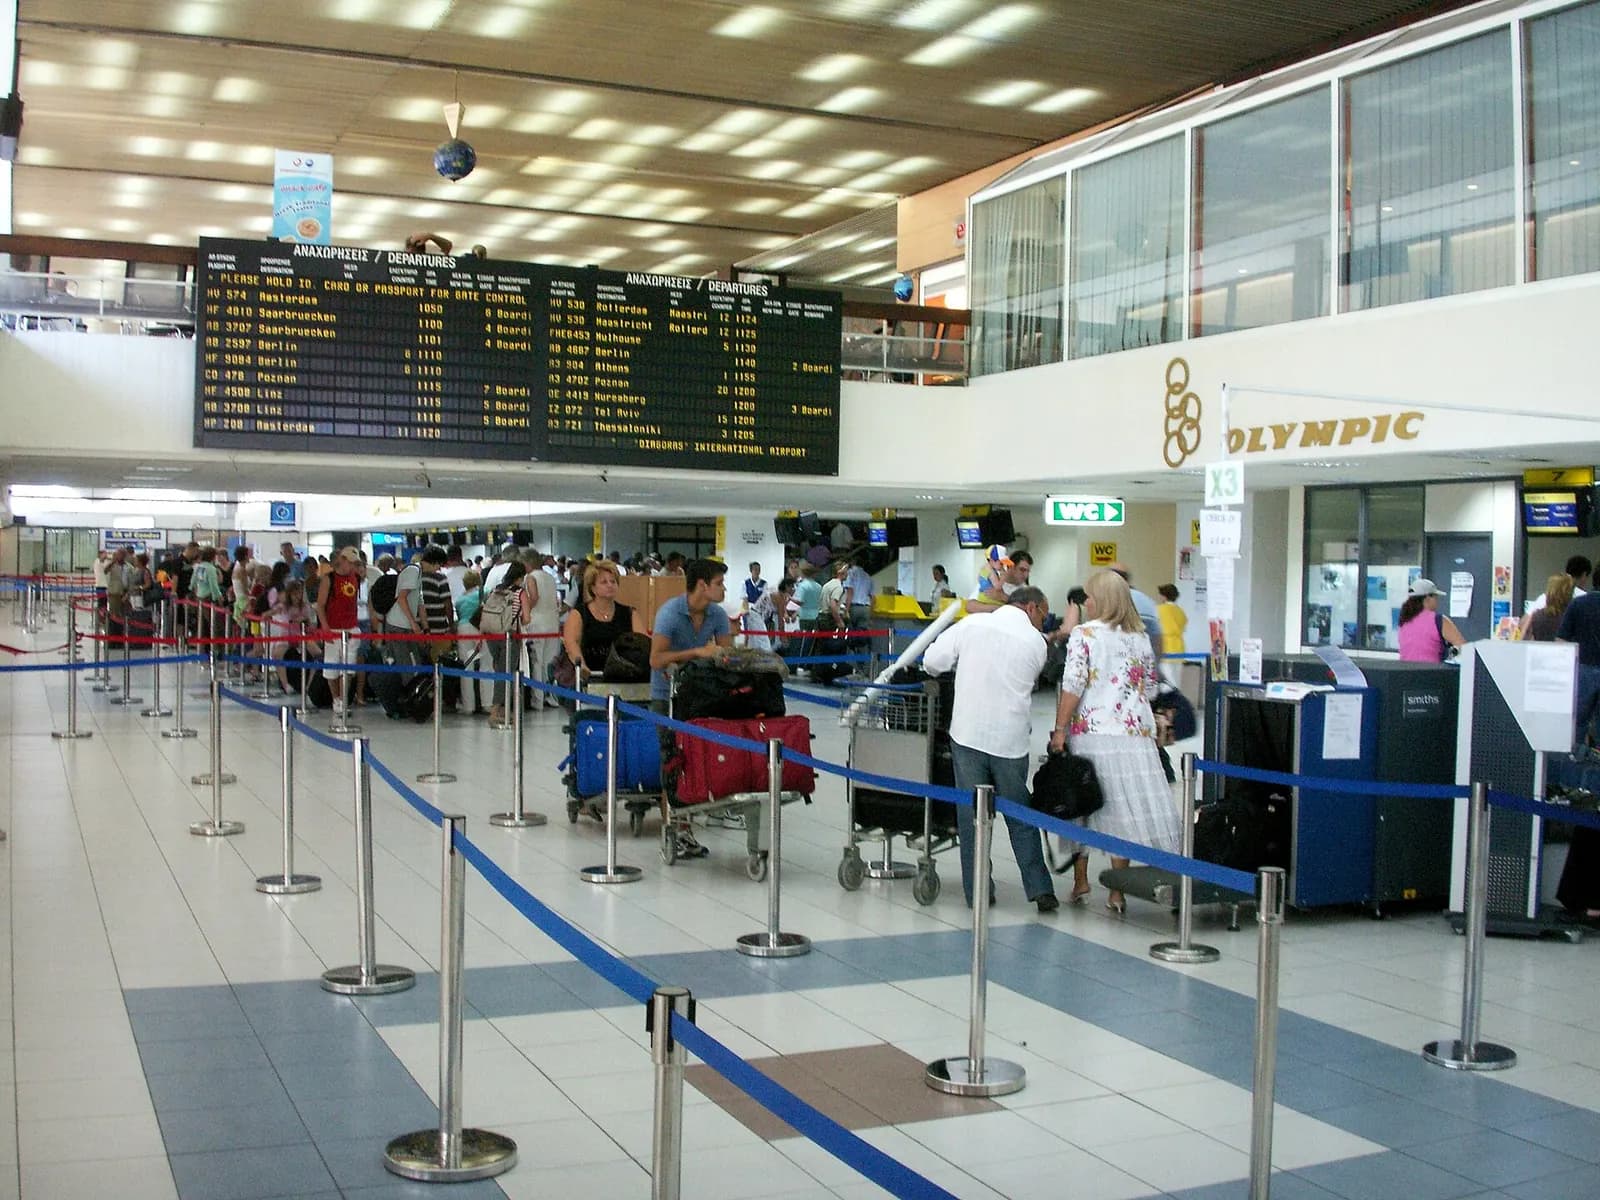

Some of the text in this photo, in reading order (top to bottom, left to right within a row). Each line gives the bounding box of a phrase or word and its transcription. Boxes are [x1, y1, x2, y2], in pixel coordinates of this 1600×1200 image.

[294, 244, 368, 262] ΑΝΑΧΩΡΗΣΕΙΣ
[374, 251, 382, 264] /
[388, 252, 456, 269] DEPARTURES
[220, 274, 260, 285] PLEASE
[266, 276, 292, 287] HOLD
[324, 280, 350, 292] CARD
[356, 283, 369, 293] OR
[374, 284, 425, 298] PASSPORT
[431, 288, 449, 299] FOR
[455, 290, 480, 302] GATE
[486, 293, 526, 305] CONTROL
[626, 272, 692, 290] ΑΝΑΧΩΡΗΣΕΙΣ
[697, 280, 703, 291] /
[708, 280, 768, 297] DEPARTURES
[260, 292, 318, 305] Amsterdam
[419, 303, 443, 314] 1050
[567, 299, 585, 310] 530
[596, 302, 648, 316] Rotterdam
[720, 313, 730, 322] 12
[259, 308, 336, 323] Saarbruecken
[419, 319, 443, 330] 1100
[567, 314, 585, 325] 530
[596, 317, 652, 331] Maastricht
[720, 328, 729, 337] 12
[226, 322, 252, 334] 3707
[258, 323, 336, 338] Saarbruecken
[418, 335, 441, 345] 1101
[595, 332, 641, 345] Mulhouse
[735, 343, 756, 353] 1130
[258, 339, 297, 352] Berlin
[418, 349, 442, 361] 1110
[595, 347, 630, 358] Berlin
[735, 358, 756, 368] 1140
[257, 355, 297, 368] Berlin
[418, 365, 442, 376] 1110
[595, 362, 629, 373] Athens
[257, 371, 297, 384] Poznan
[595, 377, 629, 388] Poznan
[717, 385, 728, 395] 20
[735, 386, 755, 397] 1200
[257, 388, 282, 399] Linz
[594, 392, 646, 405] Nuremberg
[734, 401, 755, 411] 1200
[792, 405, 797, 414] 3
[257, 405, 282, 416] Linz
[594, 407, 611, 417] Tel
[617, 409, 640, 418] Aviv
[734, 416, 754, 426] 1200
[256, 420, 314, 433] Amsterdam
[594, 421, 661, 435] Thessaloniki
[722, 430, 727, 439] 3
[1229, 412, 1424, 454] OLYMPIC
[694, 442, 764, 455] INTERNATIONAL
[770, 447, 807, 457] AIRPORT
[1210, 468, 1238, 498] X3
[1058, 503, 1099, 520] WC
[1095, 545, 1113, 555] WC
